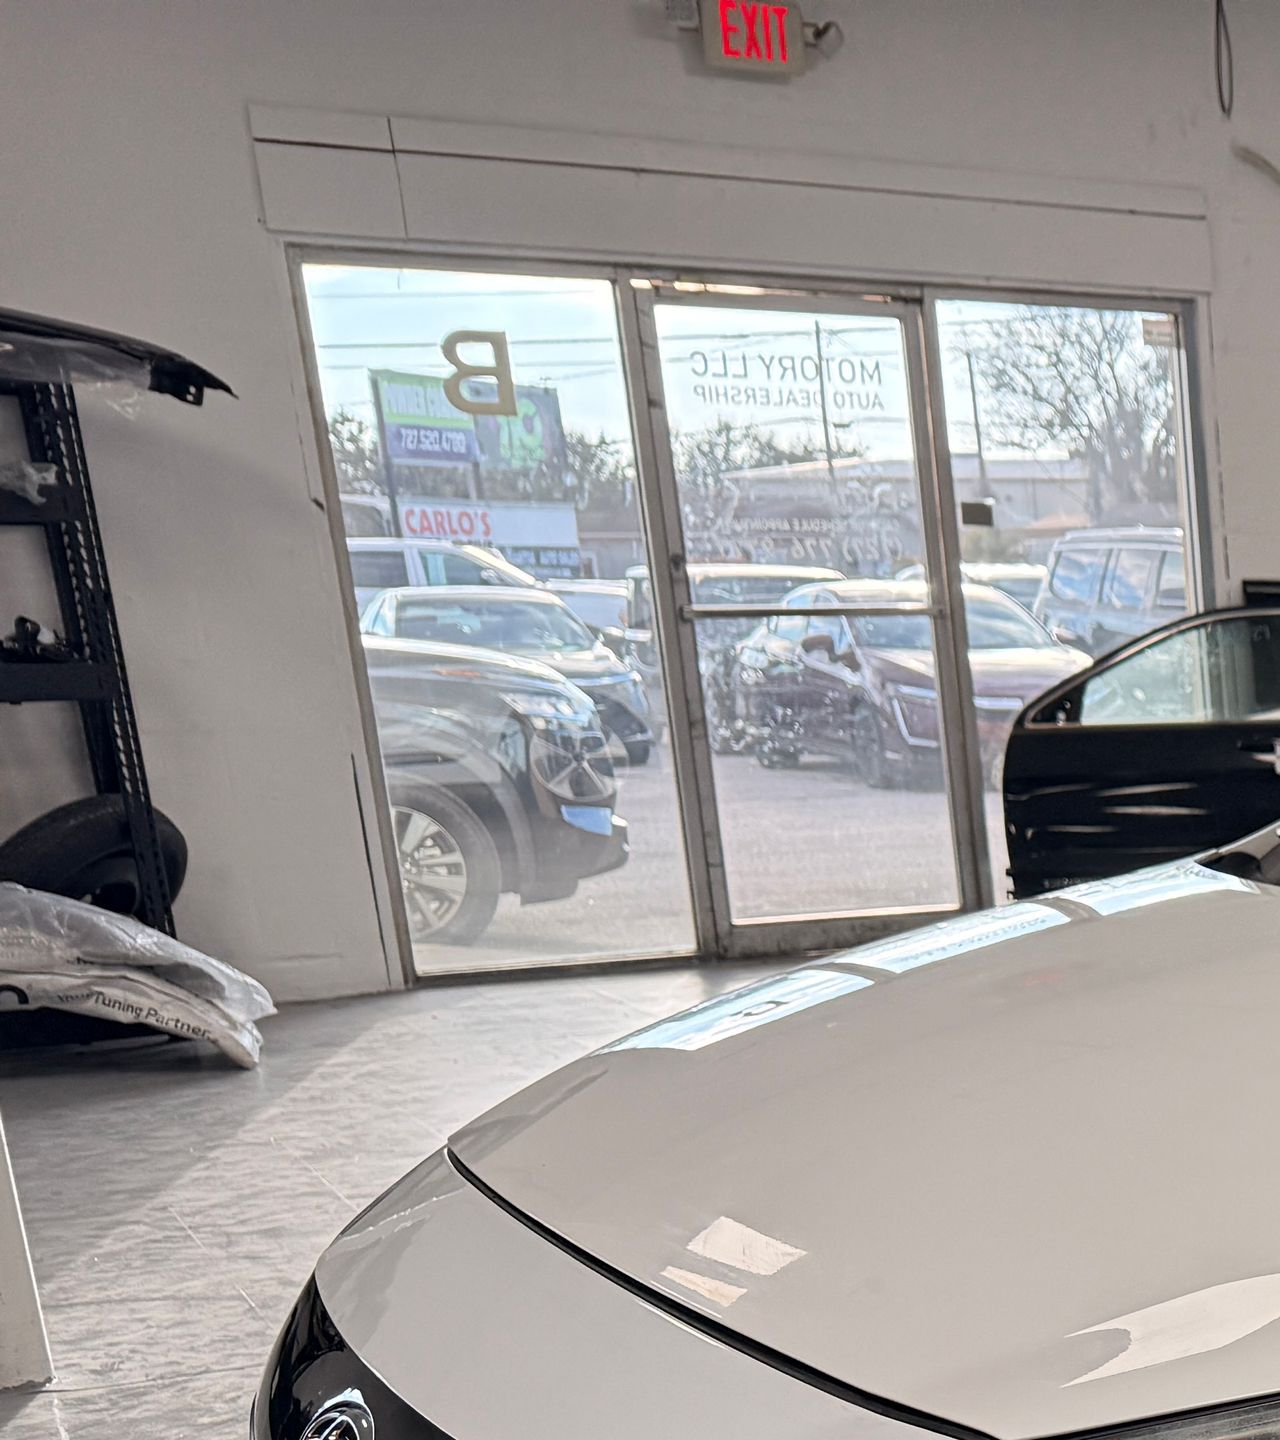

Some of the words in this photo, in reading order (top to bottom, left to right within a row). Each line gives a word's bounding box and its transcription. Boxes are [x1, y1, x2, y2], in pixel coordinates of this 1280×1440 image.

[719, 0, 788, 64] EXIT
[405, 508, 492, 537] CARLO'S
[95, 990, 143, 1019] Tuning
[145, 1007, 212, 1038] Partner
